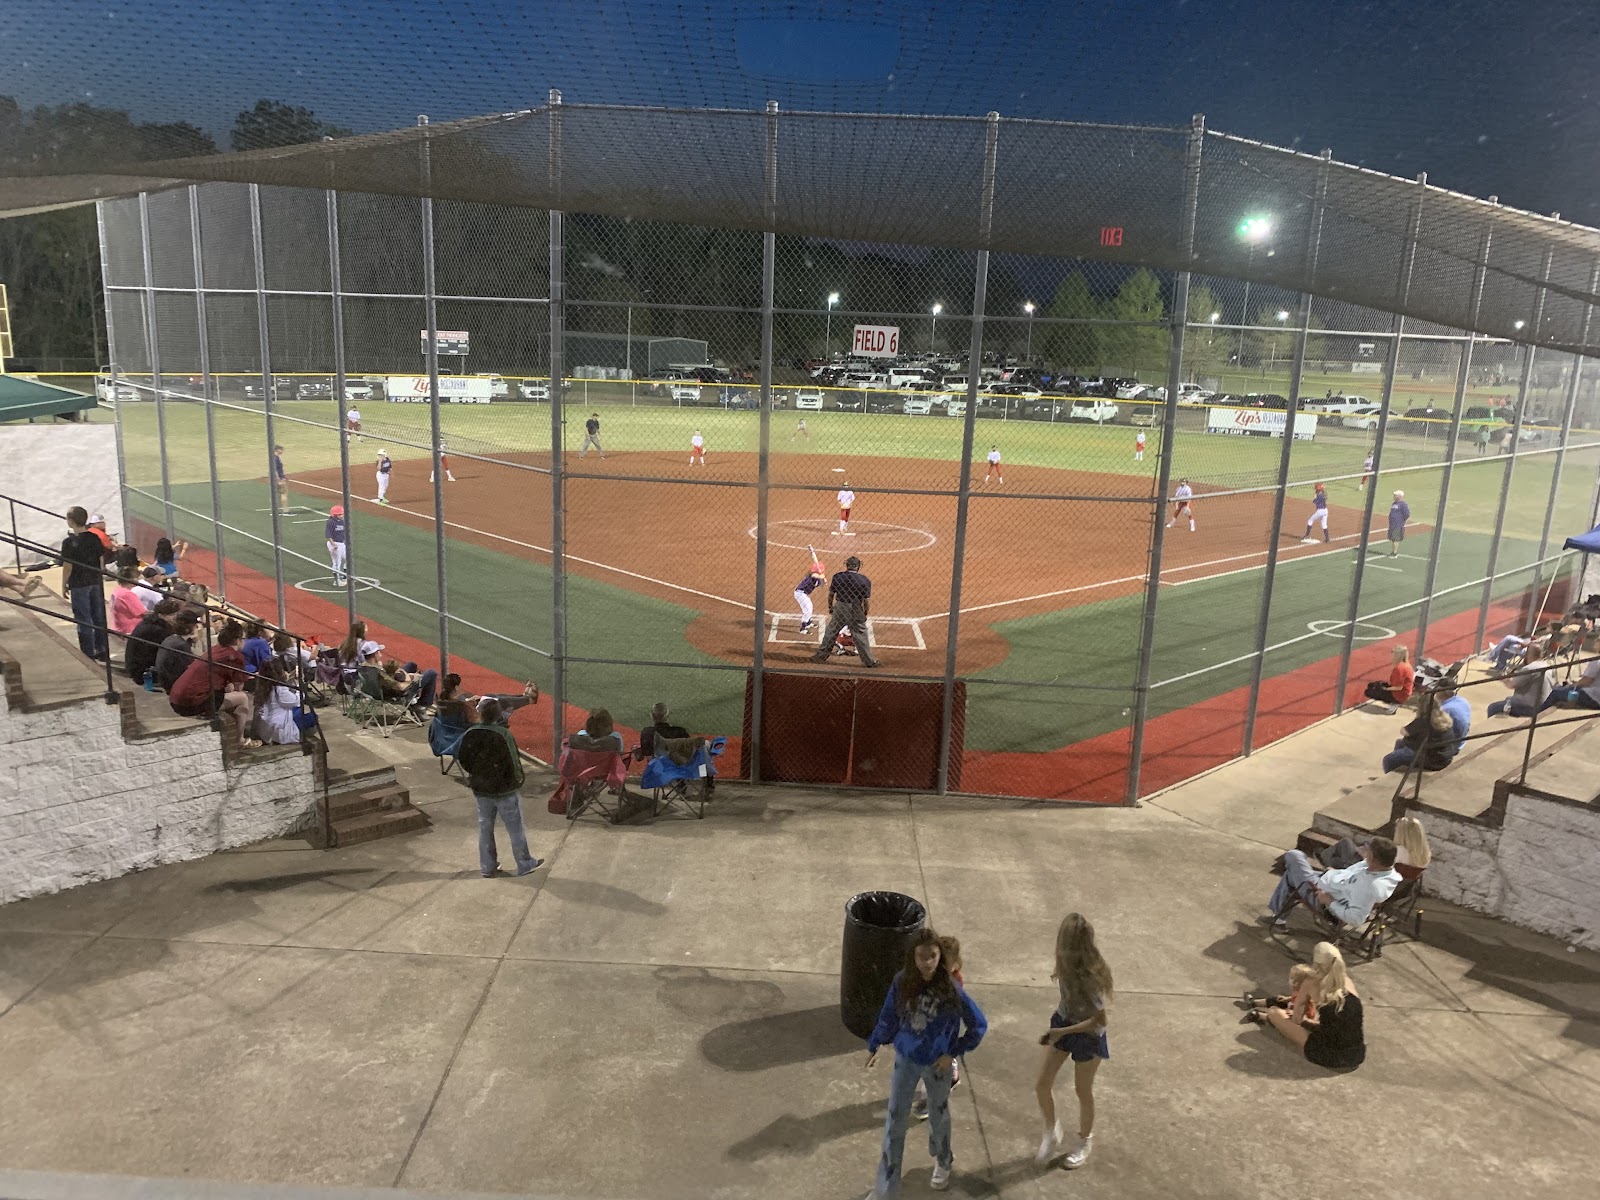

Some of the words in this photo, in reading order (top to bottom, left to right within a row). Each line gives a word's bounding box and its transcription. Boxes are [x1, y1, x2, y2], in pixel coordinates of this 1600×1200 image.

[855, 330, 886, 352] FIELD
[890, 332, 897, 353] 6
[1234, 410, 1261, 426] Zip's
